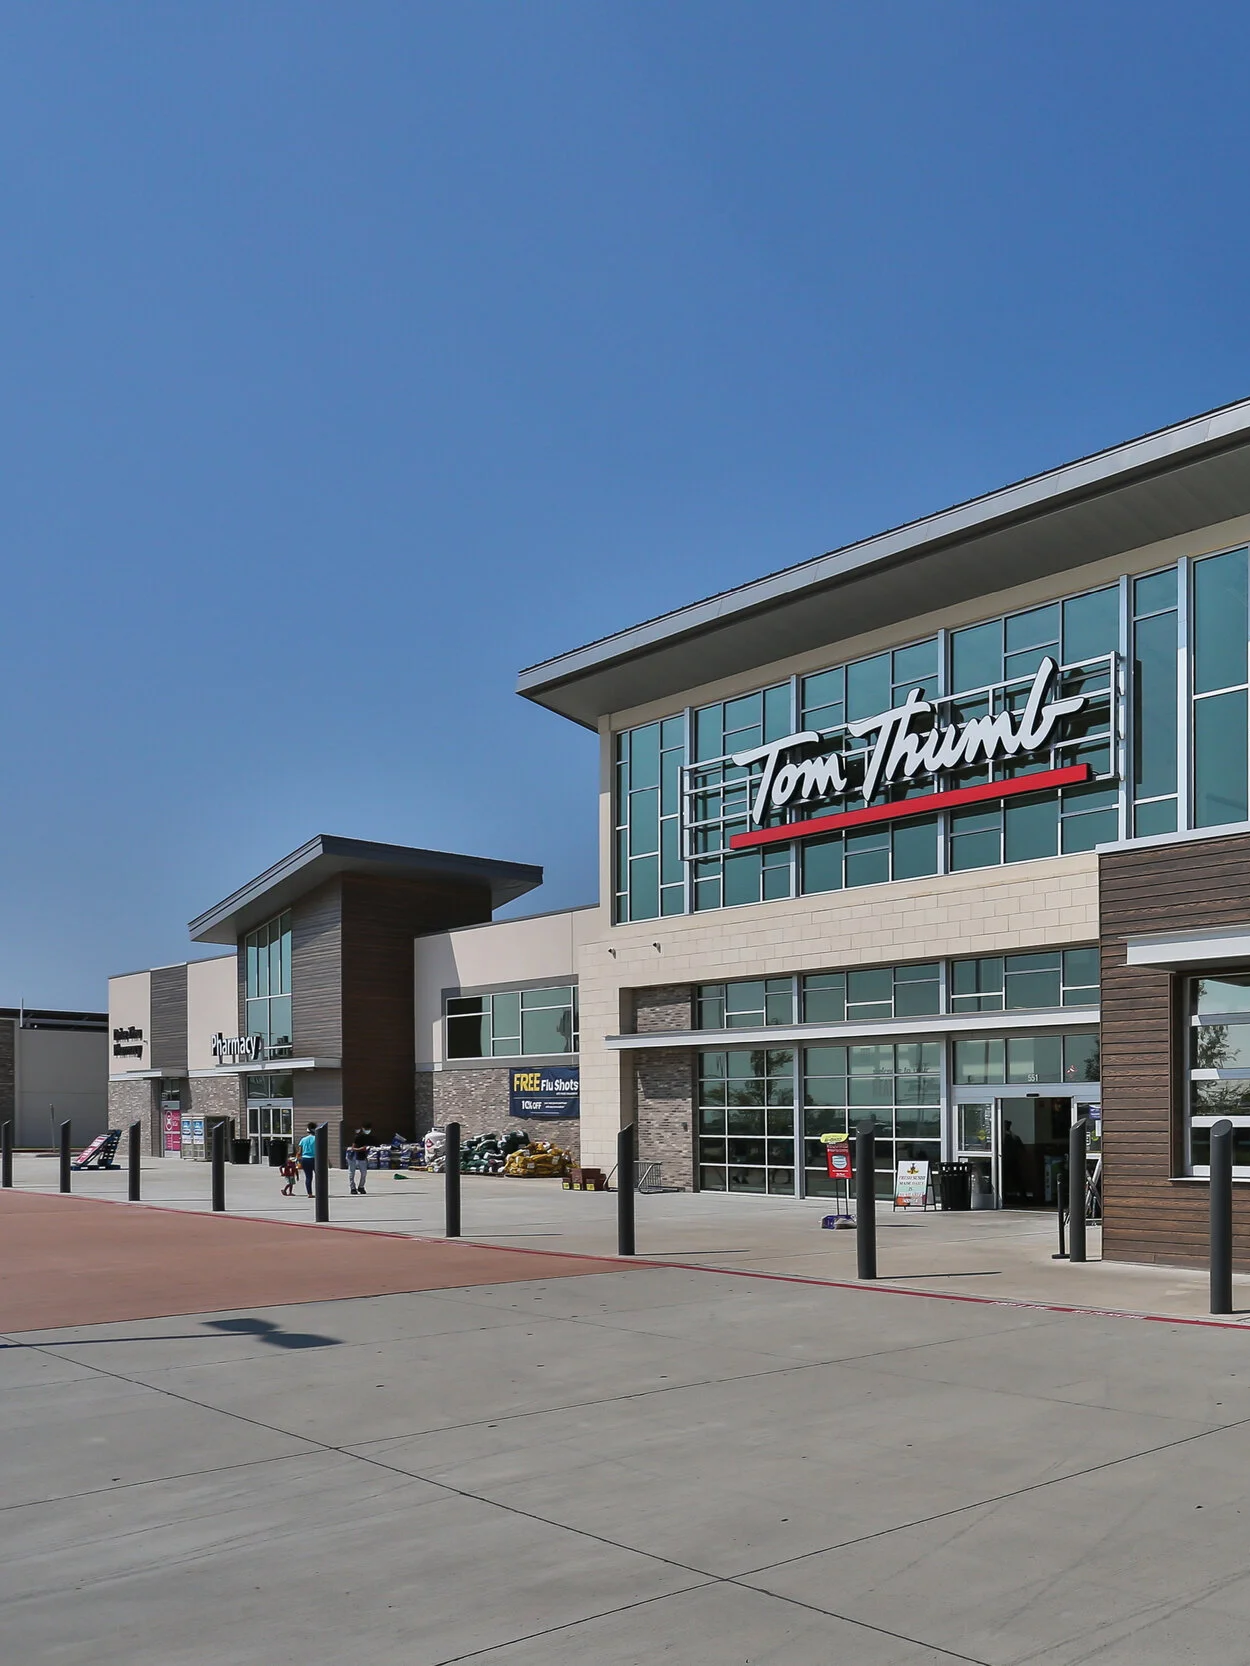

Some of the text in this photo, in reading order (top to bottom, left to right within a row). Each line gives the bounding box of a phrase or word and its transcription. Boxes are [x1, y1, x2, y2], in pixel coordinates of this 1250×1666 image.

[731, 656, 1088, 825] Tom Thumb
[211, 1033, 257, 1061] Pharmacy
[514, 1073, 579, 1091] FREE Flu Shots
[1027, 1073, 1039, 1082] 551
